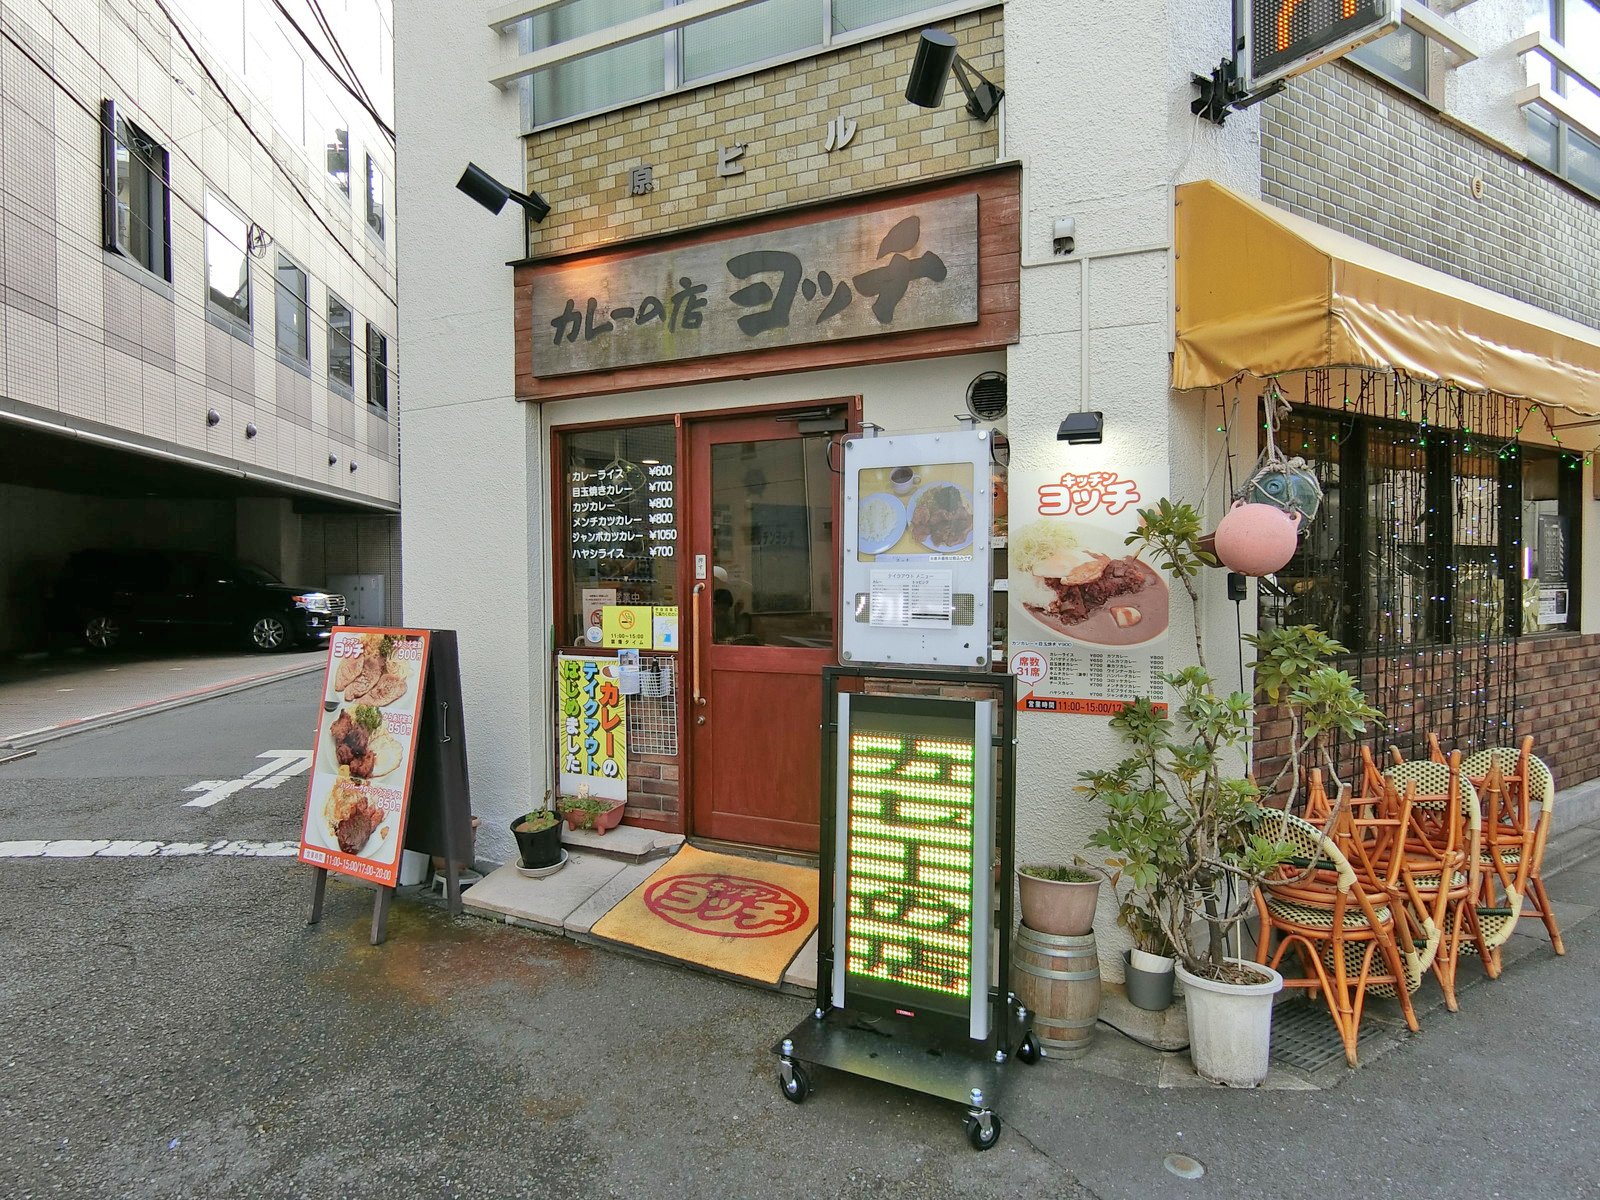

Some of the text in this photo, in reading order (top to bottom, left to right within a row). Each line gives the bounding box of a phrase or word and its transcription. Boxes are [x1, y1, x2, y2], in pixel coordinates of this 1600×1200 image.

[550, 214, 948, 346] カレーの店 ヨッチ
[572, 464, 673, 482] カレーライス ¥600
[1060, 471, 1119, 488] キッチン
[572, 480, 673, 498] 目玉焼きカレー ¥700
[572, 497, 673, 513] カツカレー ¥800
[1037, 480, 1141, 516] ヨッチ
[572, 512, 673, 528] メンチカツカレー ¥800
[572, 528, 678, 543] ジャンボカツカレー ¥1050
[572, 545, 674, 560] ハヤシライス ¥700
[334, 642, 365, 659] ヨッチ
[1018, 657, 1040, 667] 席数
[1016, 667, 1041, 677] 31席
[1028, 700, 1055, 709] 営業時間
[563, 660, 582, 774] はじめました
[582, 662, 601, 776] テイクアウト
[599, 681, 622, 778] カレーの
[657, 882, 793, 928] ヨッチ
